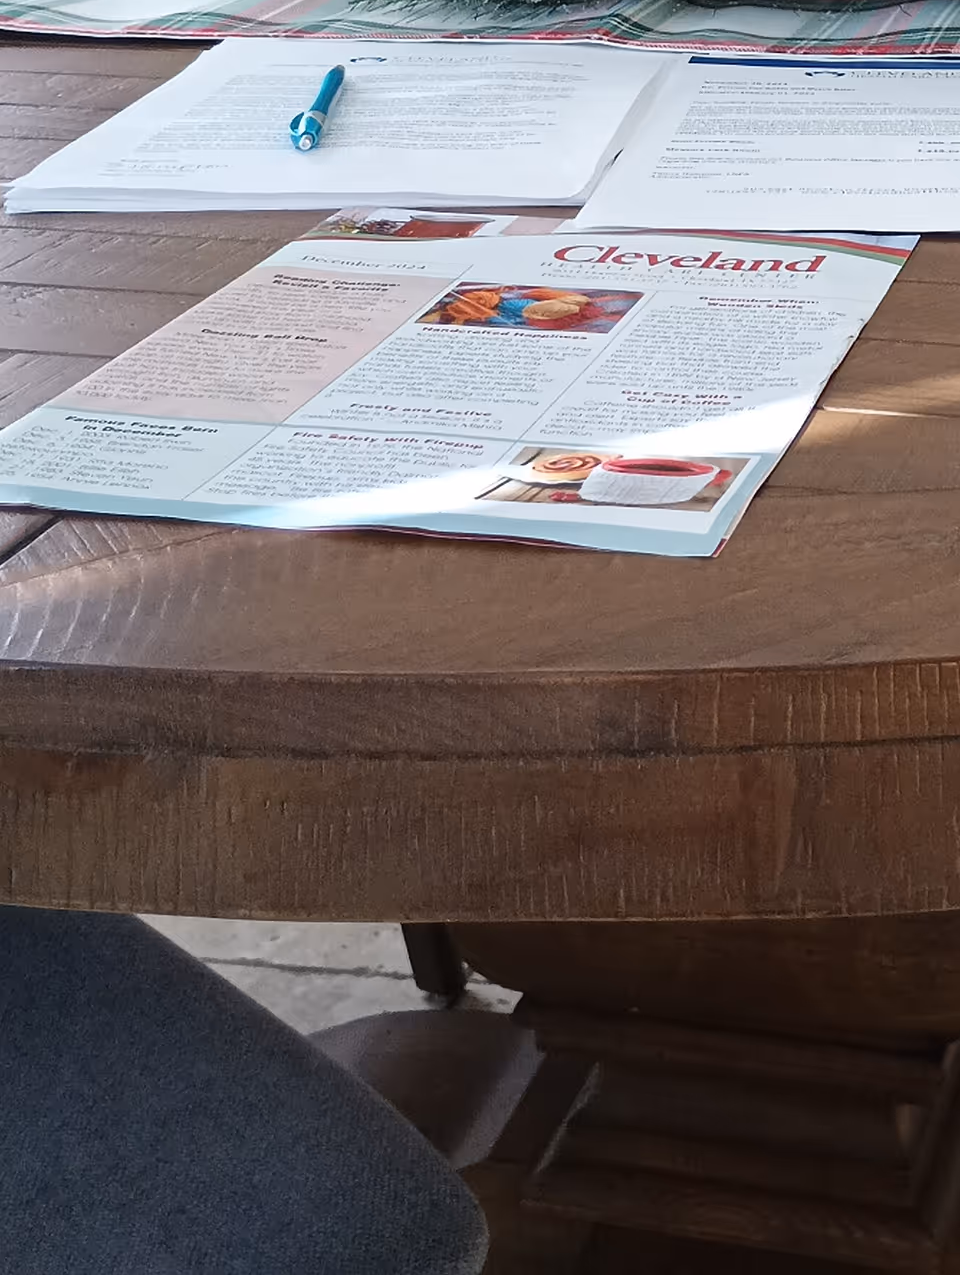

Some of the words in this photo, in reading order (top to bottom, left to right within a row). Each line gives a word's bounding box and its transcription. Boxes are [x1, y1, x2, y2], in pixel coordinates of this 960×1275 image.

[301, 255, 381, 268] December
[553, 244, 828, 272] Cleveland
[64, 416, 126, 425] Famous
[130, 422, 177, 430] Faces
[101, 426, 182, 437] December
[328, 434, 379, 443] Safety
